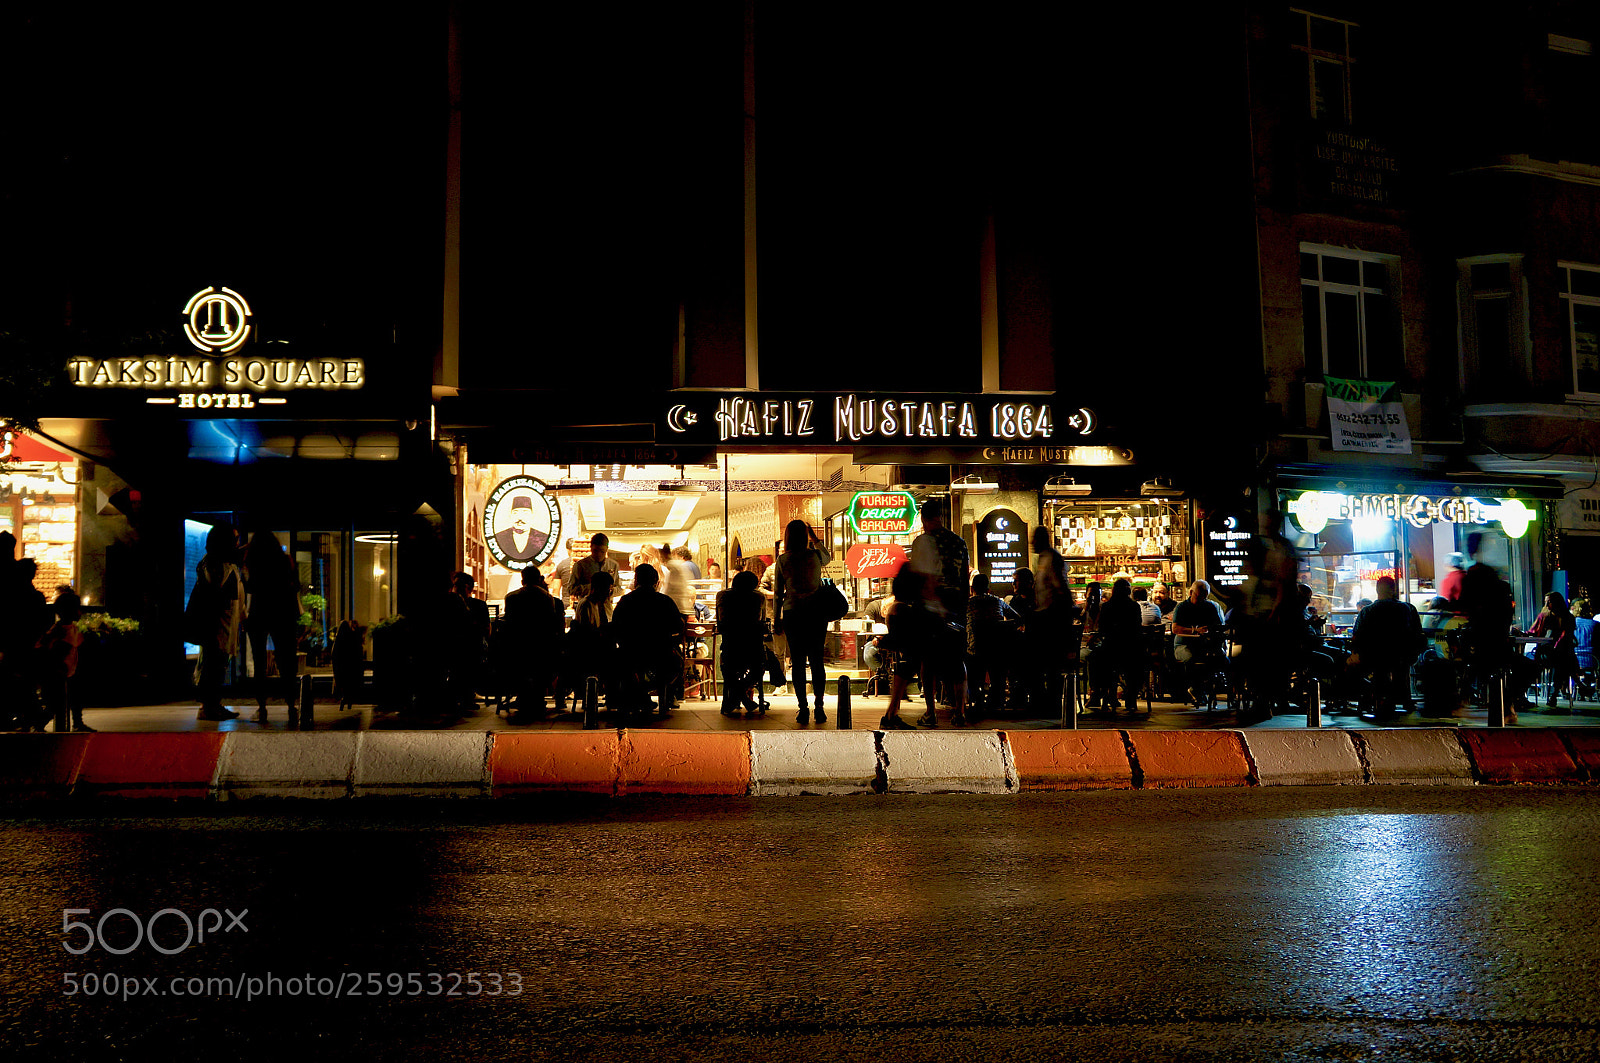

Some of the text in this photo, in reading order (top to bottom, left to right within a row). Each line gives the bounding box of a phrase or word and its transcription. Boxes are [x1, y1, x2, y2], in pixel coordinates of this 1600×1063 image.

[224, 358, 363, 388] SQUARE
[178, 393, 255, 408] HOTEL
[715, 394, 1054, 442] HAFIZ MUSTAFA 1864
[1002, 446, 1034, 462] HAFIZ
[1040, 446, 1087, 462] MUSTAFA
[860, 495, 906, 506] TURKISH
[860, 508, 907, 519] DELIGHT
[860, 520, 907, 531] BAKLAVA
